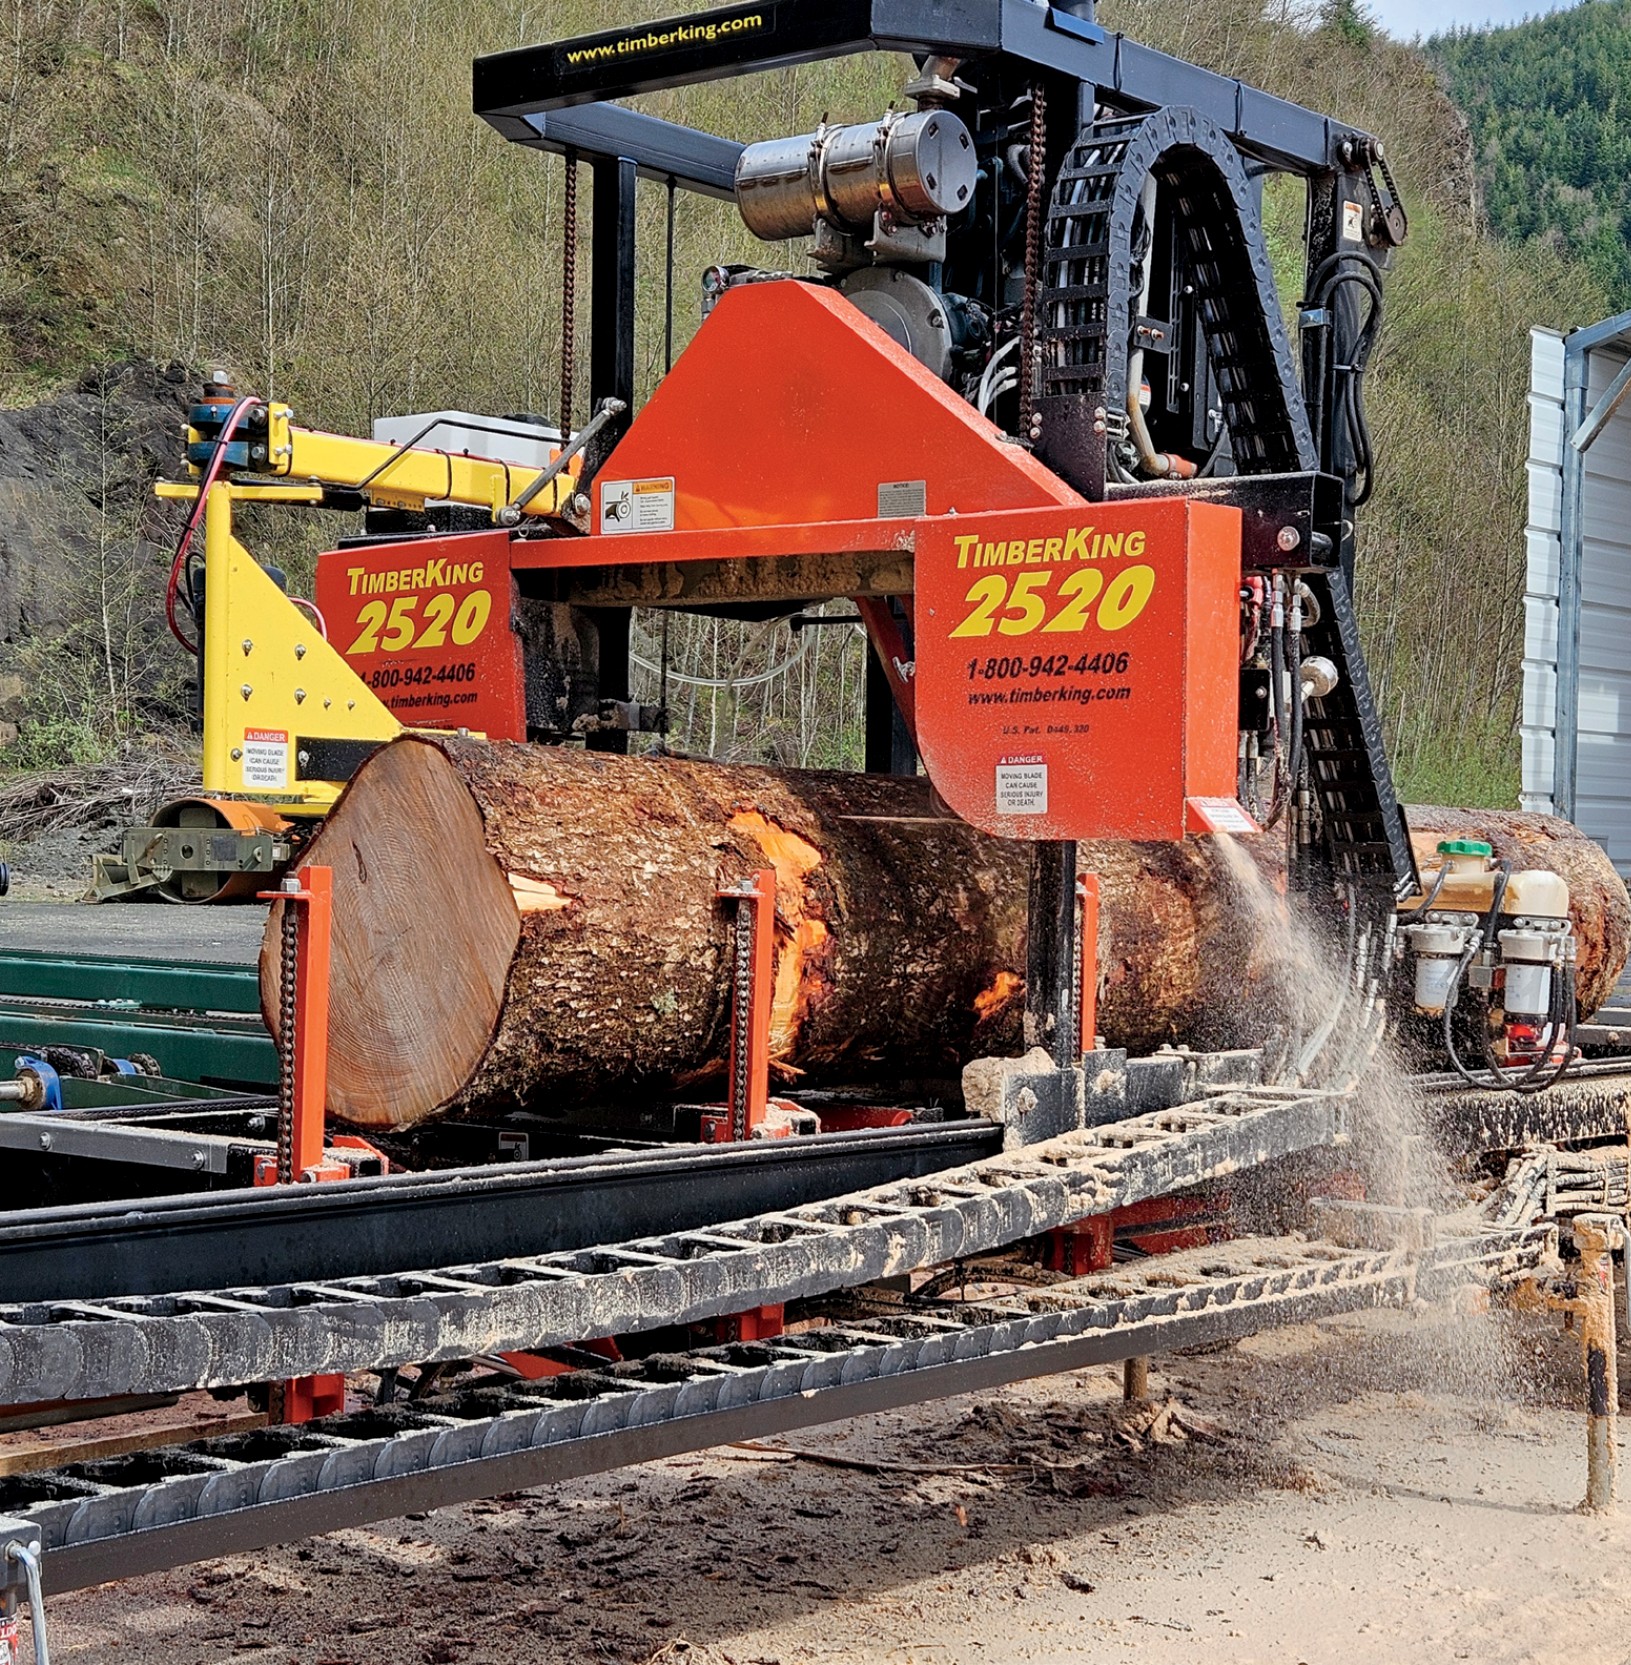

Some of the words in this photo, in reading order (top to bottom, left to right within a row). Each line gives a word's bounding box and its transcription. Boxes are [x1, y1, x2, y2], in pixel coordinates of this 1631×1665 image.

[566, 12, 763, 64] www.timberking.com
[949, 564, 1156, 638] 2520
[345, 589, 492, 655] 2520
[967, 652, 1130, 680] 1-800-942-4406
[968, 686, 1131, 706] www.timberking.com
[254, 733, 285, 741] DANGER
[1024, 772, 1042, 780] BLADE
